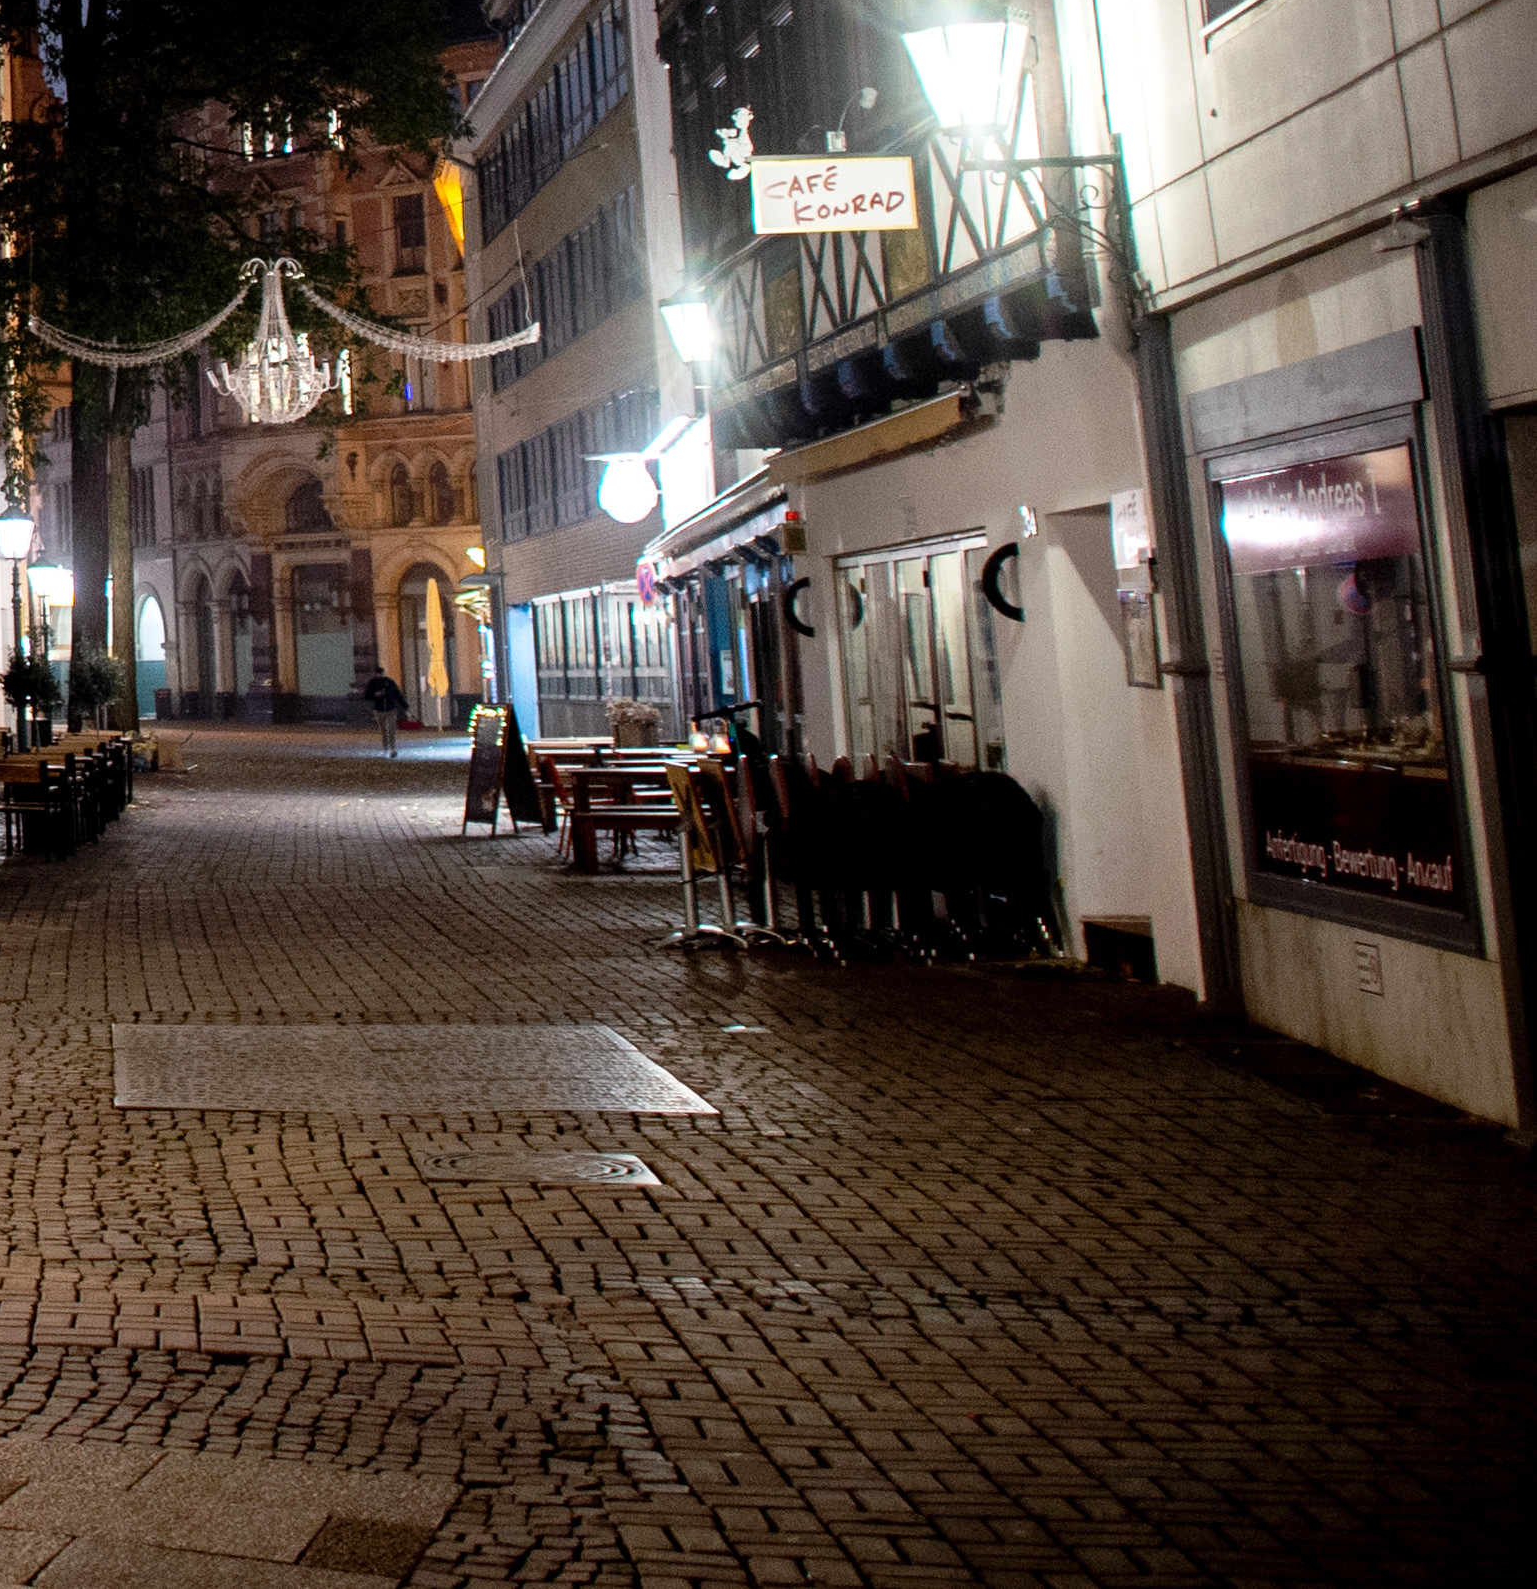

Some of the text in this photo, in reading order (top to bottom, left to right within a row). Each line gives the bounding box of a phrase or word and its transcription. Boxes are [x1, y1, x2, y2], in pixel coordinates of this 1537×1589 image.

[762, 165, 838, 200] CAFÉ
[793, 190, 904, 225] KONRAD
[1297, 470, 1367, 522] Andreas
[1266, 829, 1327, 877] Anfertigung
[1332, 839, 1399, 891] Bewertung
